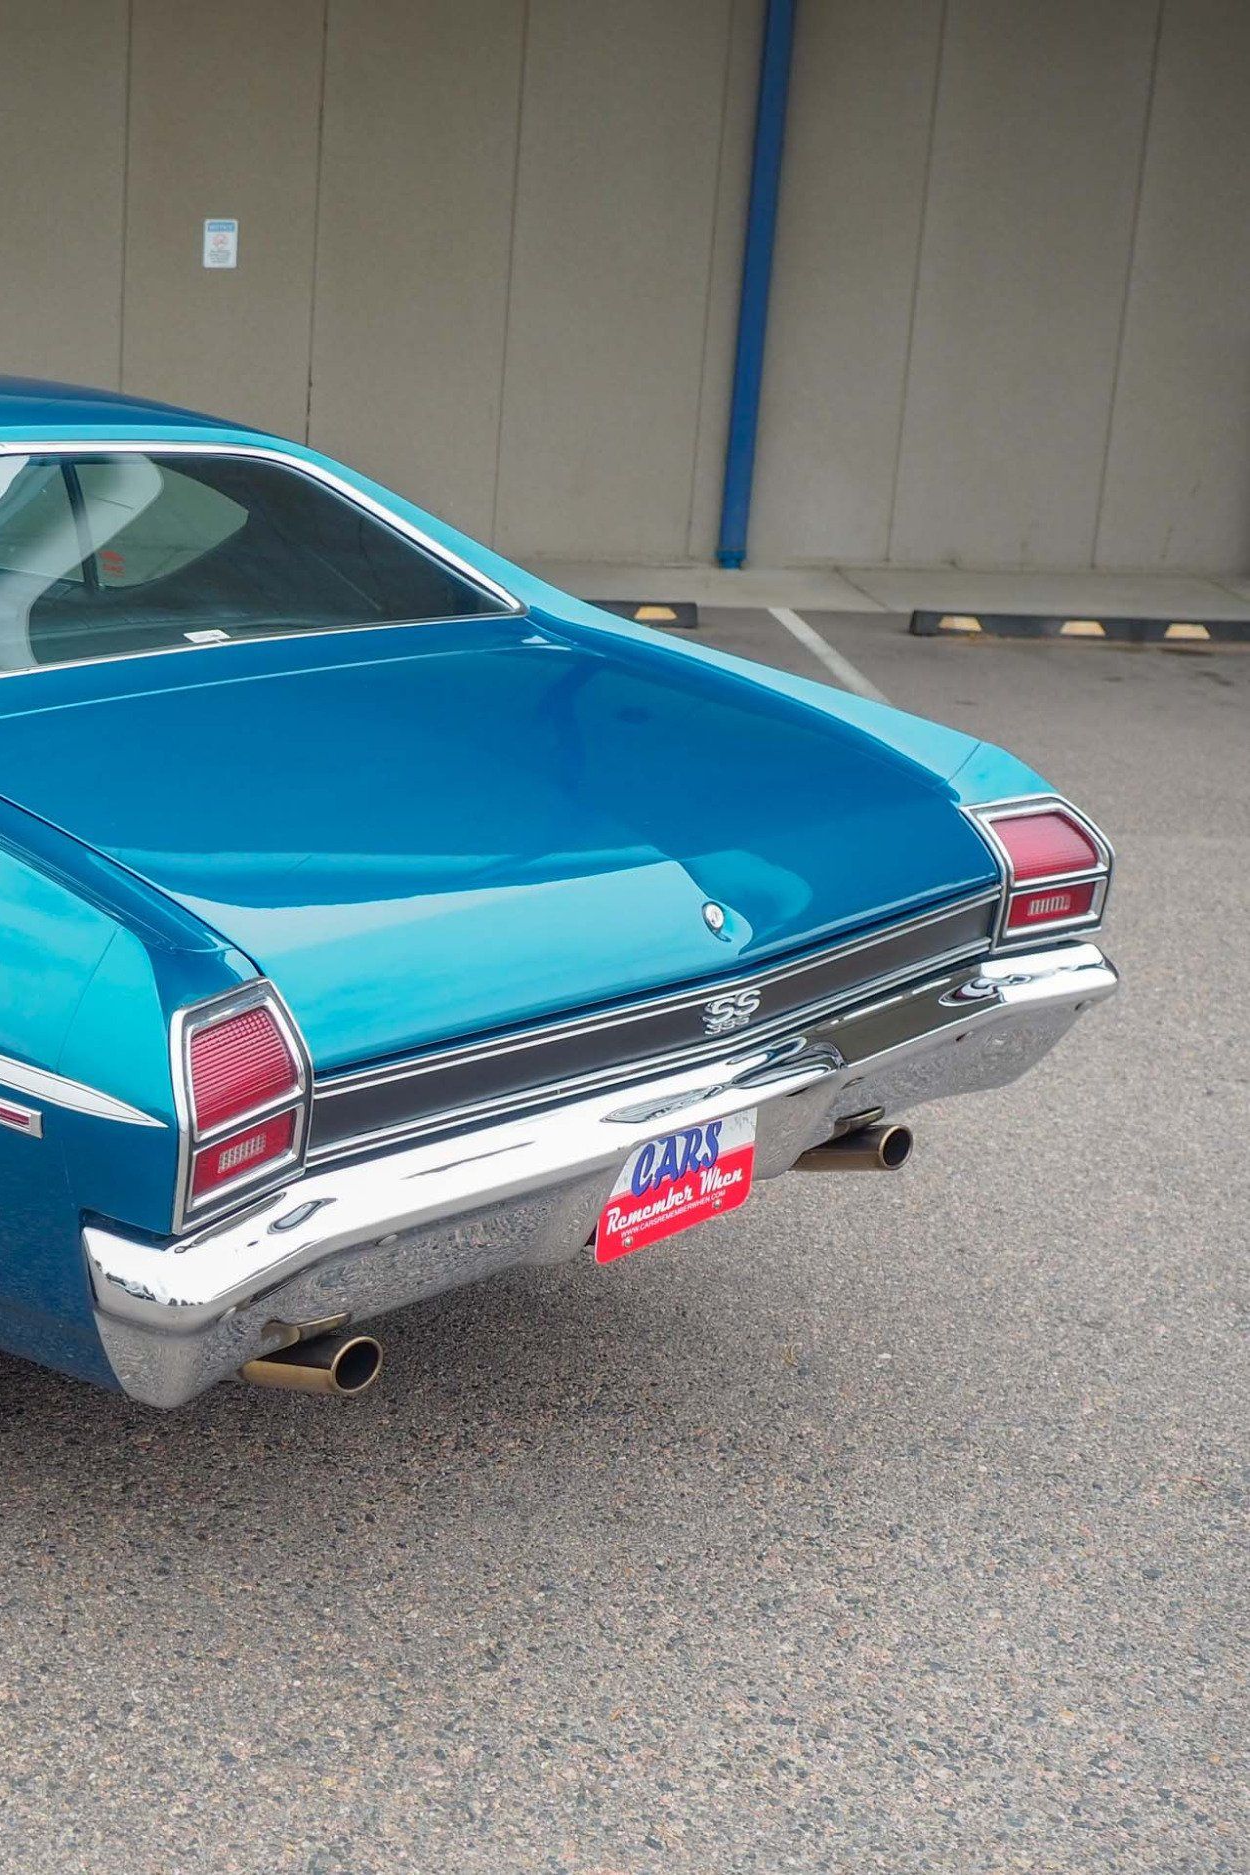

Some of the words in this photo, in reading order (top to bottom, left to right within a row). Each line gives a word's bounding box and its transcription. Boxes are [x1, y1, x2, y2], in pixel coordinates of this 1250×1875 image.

[702, 989, 761, 1024] SS
[631, 1120, 723, 1197] CARS
[606, 1186, 694, 1236] Remember
[700, 1166, 743, 1196] When
[620, 1189, 726, 1237] WWW.CARSREMEMBERWHEN.COM
